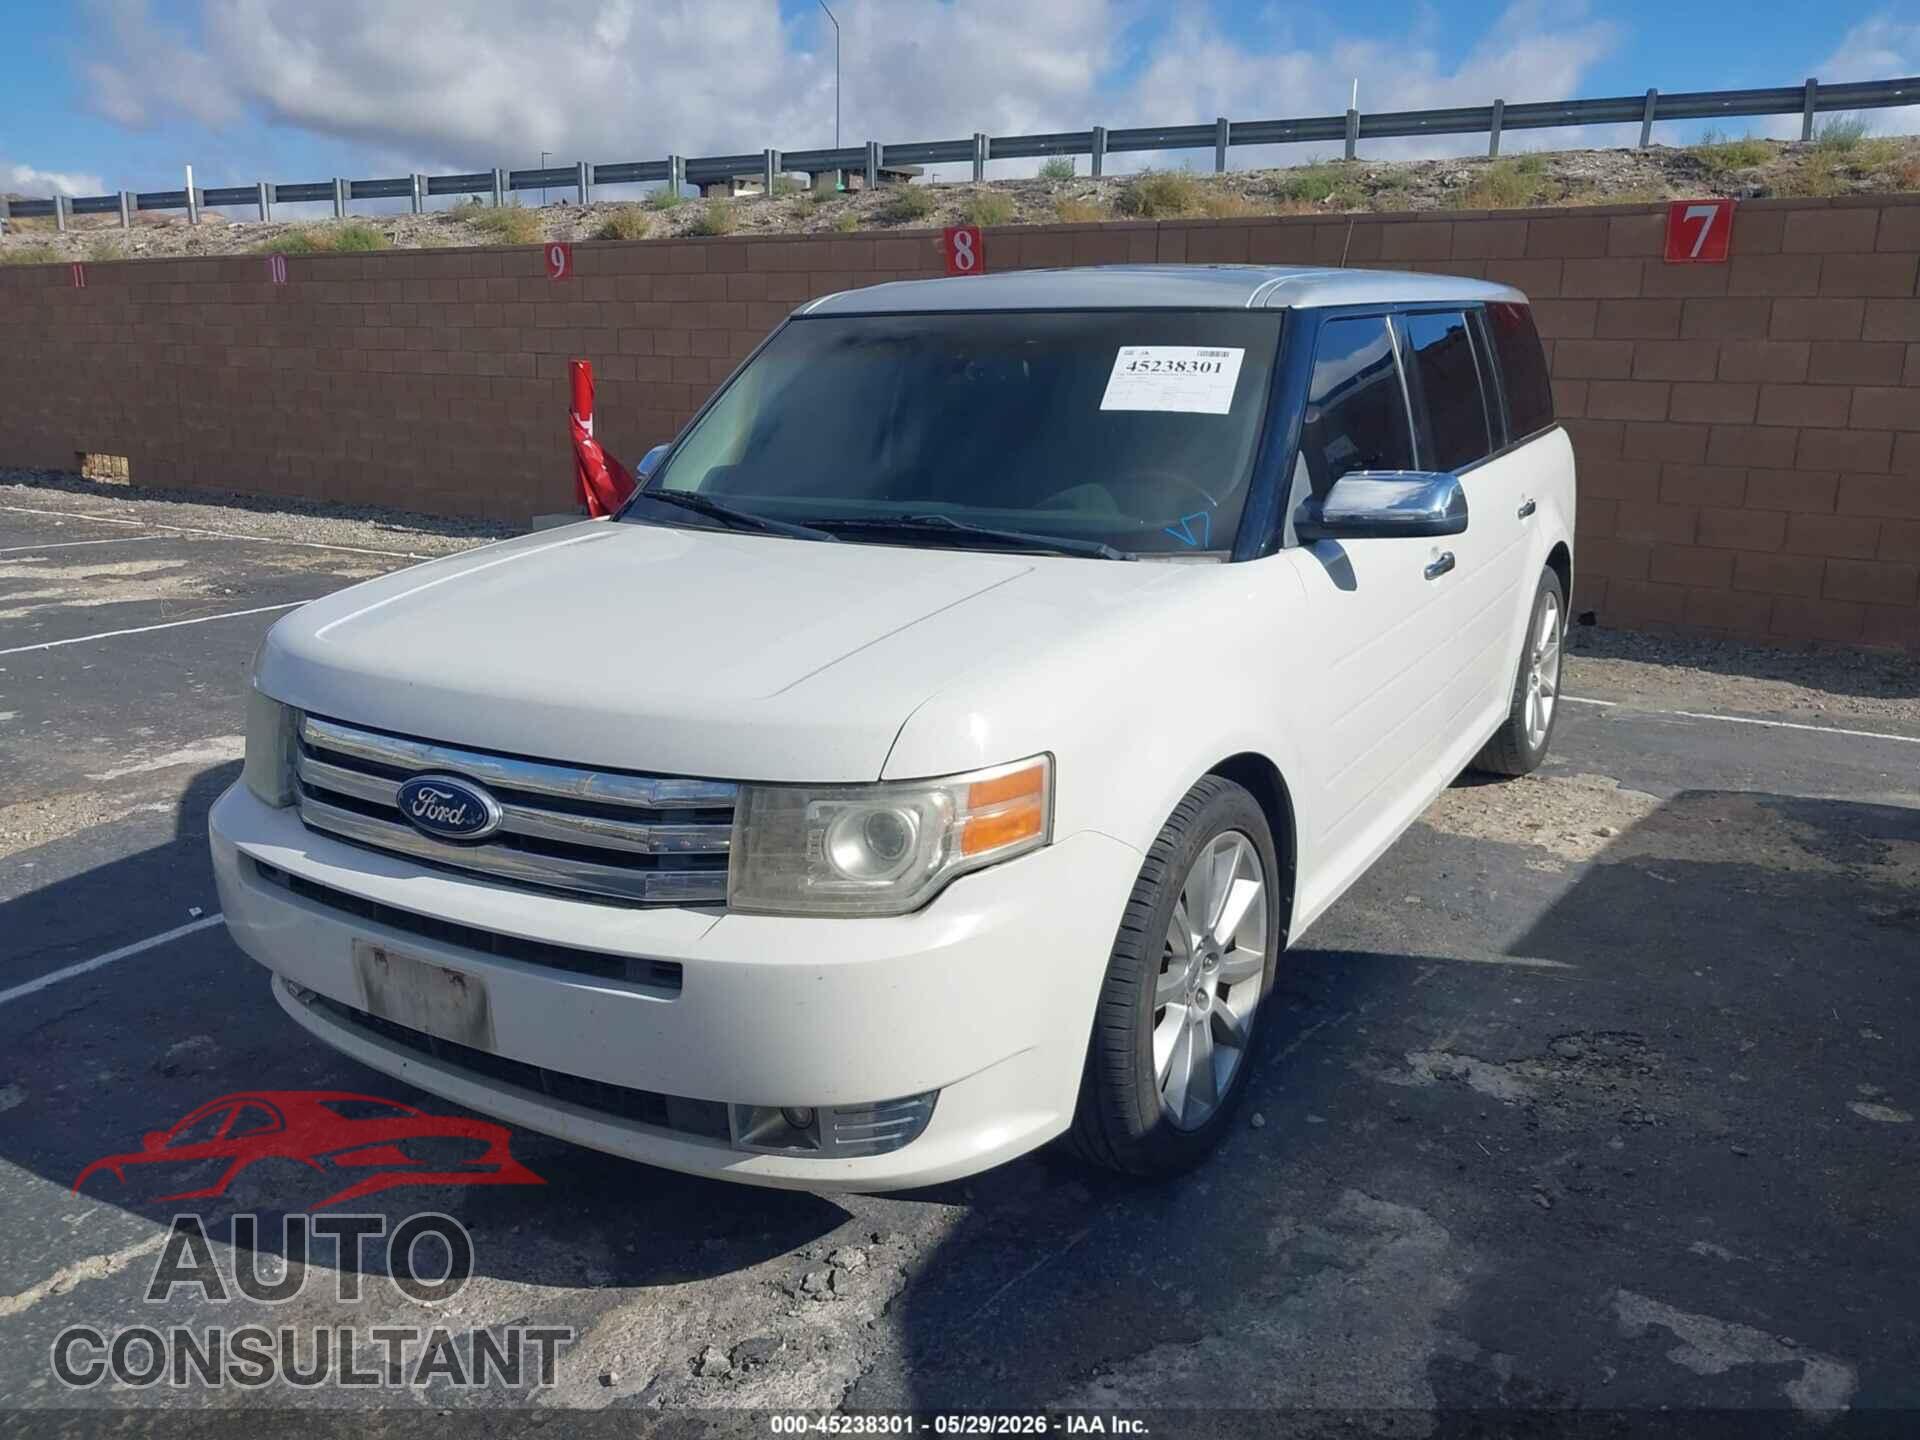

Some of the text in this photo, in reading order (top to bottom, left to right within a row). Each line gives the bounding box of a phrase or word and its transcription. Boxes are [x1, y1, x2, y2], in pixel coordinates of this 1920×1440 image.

[1683, 204, 1720, 258] 7
[551, 245, 565, 279] 9
[953, 230, 975, 271] 8
[72, 264, 86, 288] 11
[270, 254, 287, 284] 10
[1126, 359, 1223, 374] 45238301
[412, 786, 468, 825] Ford
